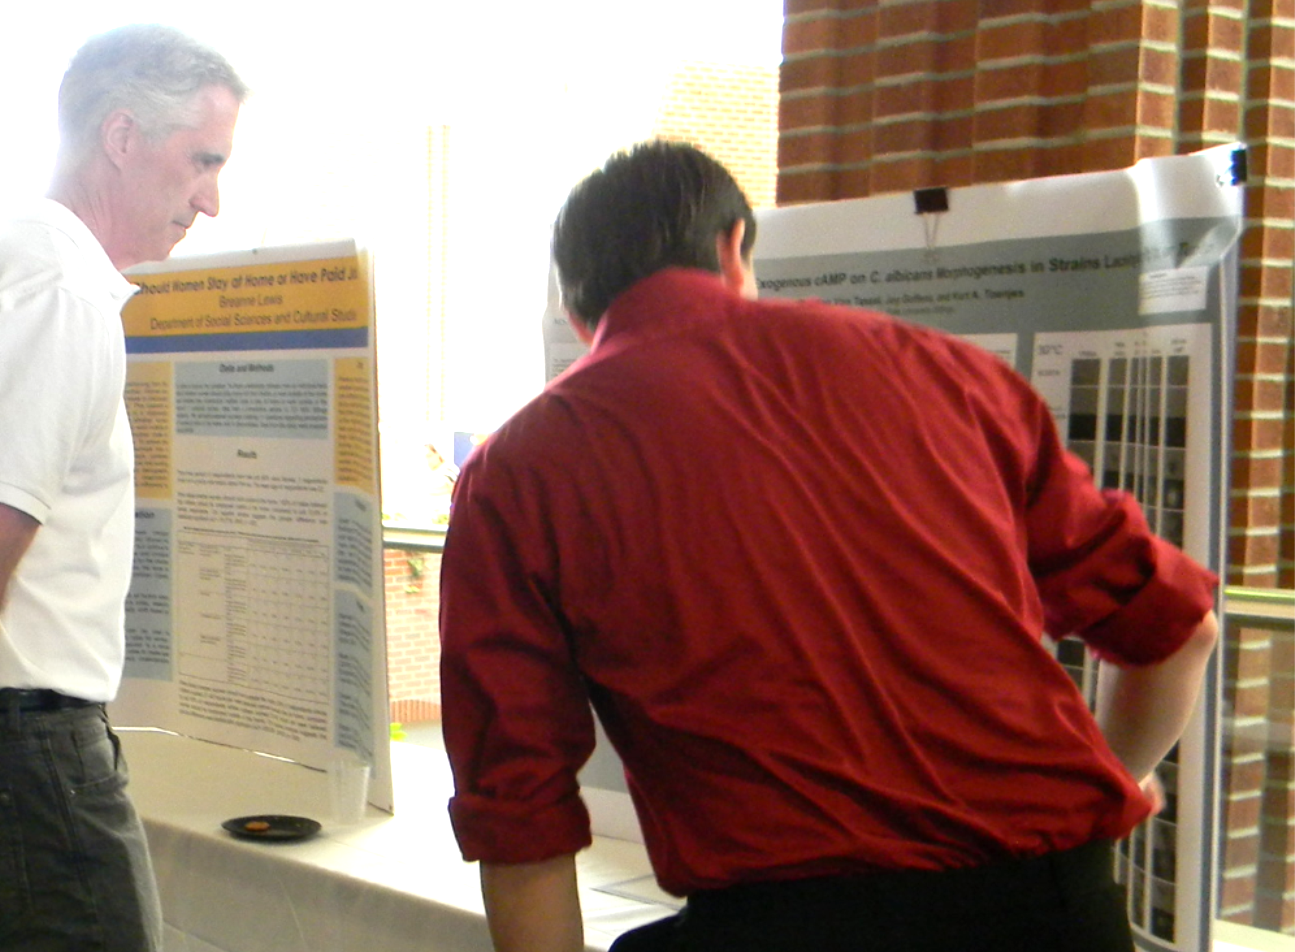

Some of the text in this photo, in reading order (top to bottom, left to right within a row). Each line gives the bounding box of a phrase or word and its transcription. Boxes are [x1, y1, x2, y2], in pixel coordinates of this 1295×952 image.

[172, 280, 204, 293] Women
[207, 276, 227, 292] Stay
[231, 275, 242, 289] at
[245, 275, 275, 288] Home
[277, 274, 287, 286] or
[290, 270, 317, 284] Have
[320, 266, 346, 282] Paid
[814, 272, 847, 287] cAMP
[849, 273, 866, 285] on
[885, 269, 933, 283] albicans
[936, 262, 1025, 280] Morphogenesis
[1030, 261, 1045, 273] in
[1049, 257, 1100, 272] Strains
[258, 293, 283, 306] Lewis
[150, 316, 193, 330] Department
[195, 315, 204, 328] of
[205, 315, 231, 328] Social
[234, 312, 272, 326] Sciences
[274, 311, 291, 324] and
[294, 309, 329, 323] Cultural
